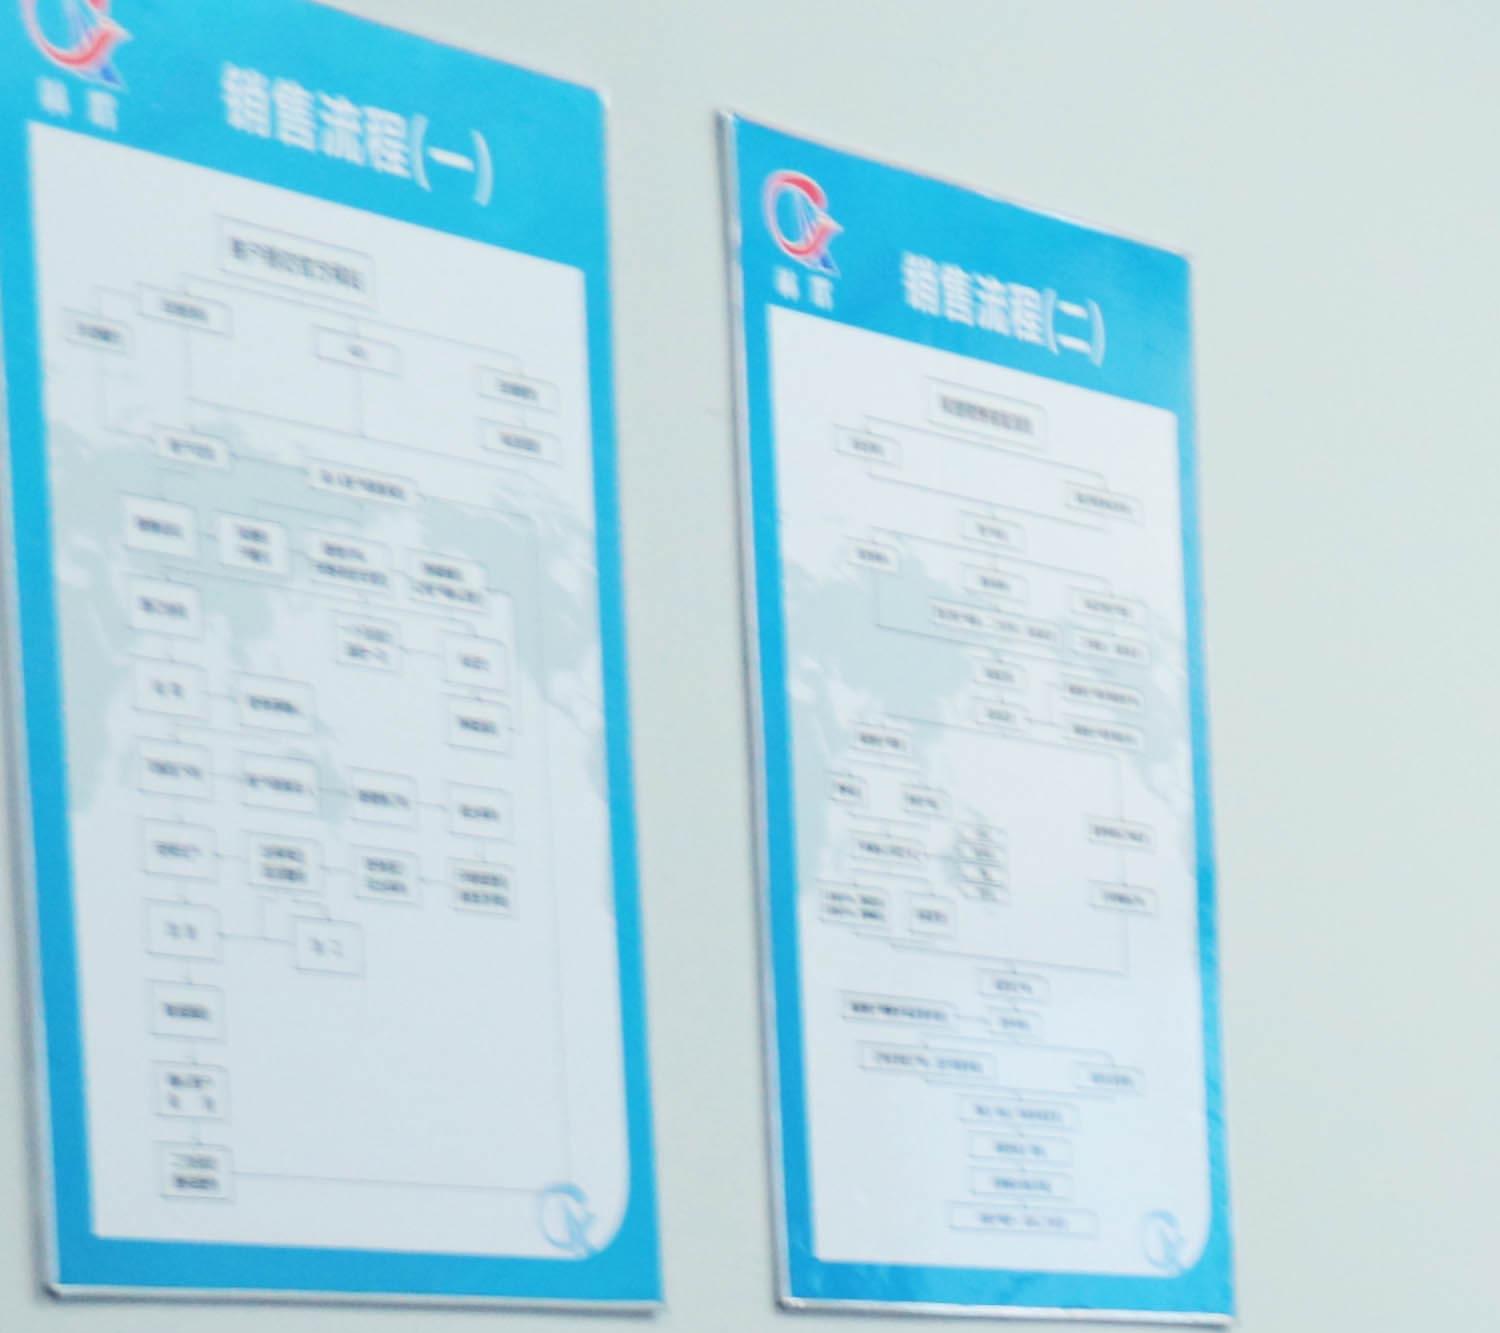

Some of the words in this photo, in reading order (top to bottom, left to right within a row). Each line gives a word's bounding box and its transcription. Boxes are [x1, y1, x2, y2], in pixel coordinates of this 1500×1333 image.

[220, 60, 494, 207] 销售流程(一)
[901, 250, 1106, 368] 销售流程(二)
